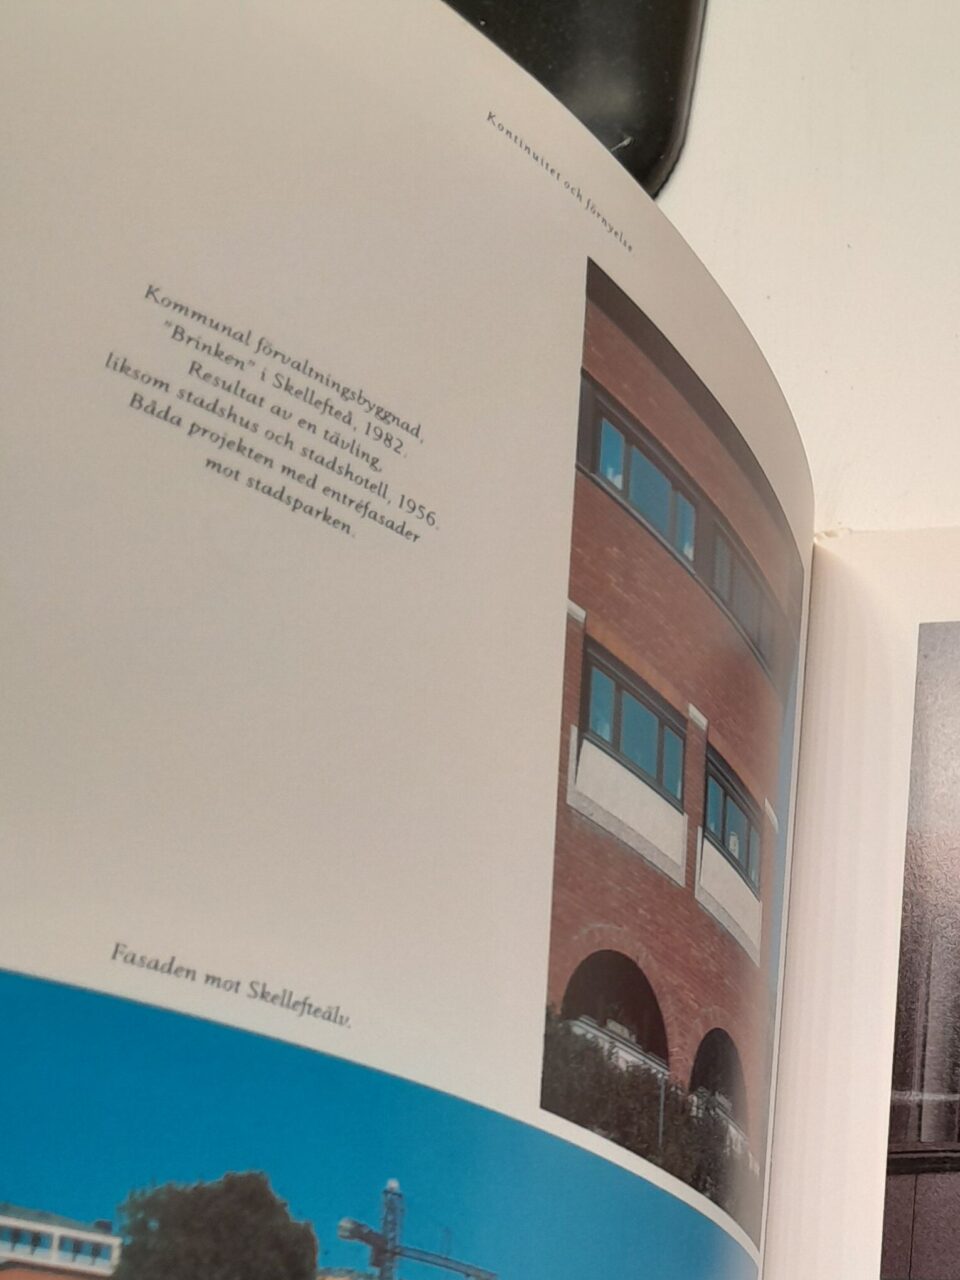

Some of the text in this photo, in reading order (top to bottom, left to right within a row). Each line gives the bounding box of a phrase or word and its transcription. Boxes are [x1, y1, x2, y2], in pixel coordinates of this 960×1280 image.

[487, 111, 561, 181] Kontinuitet
[564, 181, 583, 202] och
[144, 284, 425, 445] Kommunal förvaltningsbyggnad,
[260, 367, 267, 382] i
[272, 372, 358, 431] Skellefteå,
[105, 351, 171, 393] liksom
[176, 387, 260, 433] stadshus
[264, 428, 295, 451] och
[300, 446, 392, 505] stadshotell,
[129, 392, 421, 543] Båda projekten med entréfasader
[188, 360, 383, 473] Resultat av en tävling,
[205, 457, 241, 482] mot
[110, 942, 352, 1029] Fasaden mot Skellefteälv.
